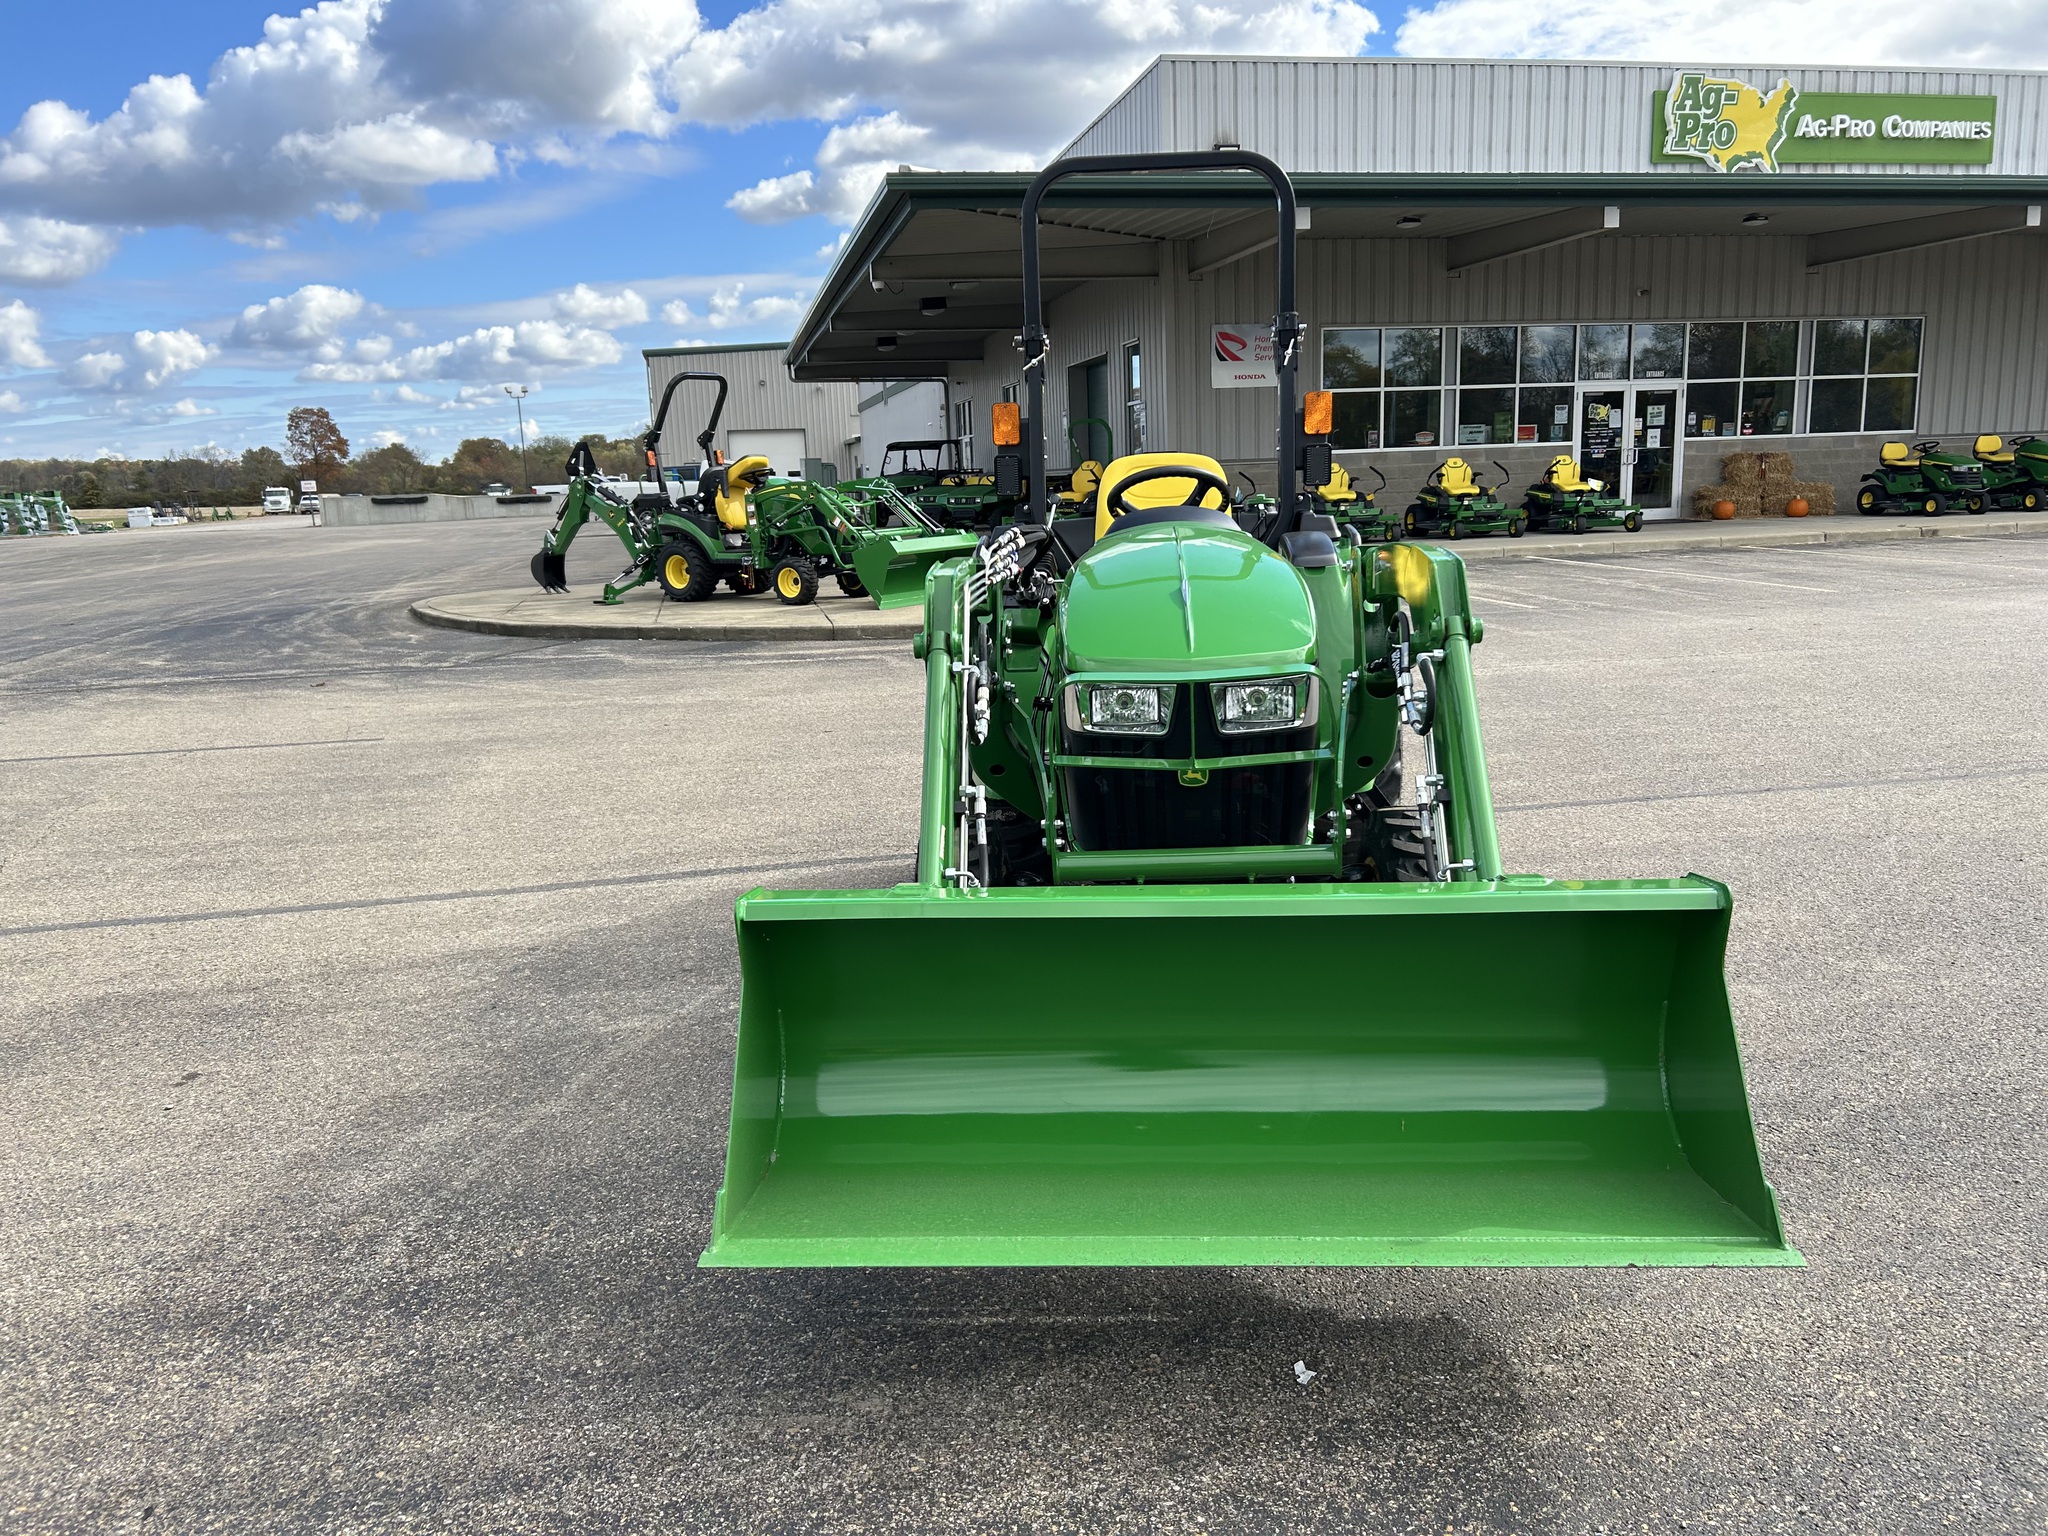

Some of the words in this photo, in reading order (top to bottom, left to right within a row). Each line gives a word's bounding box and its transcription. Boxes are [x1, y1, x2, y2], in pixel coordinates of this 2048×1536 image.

[1673, 74, 1738, 121] Ag-
[1671, 112, 1737, 149] Pro
[1883, 115, 1992, 139] COMPANIES
[1254, 335, 1271, 343] Hon
[1646, 370, 1665, 378] ENTRANCE
